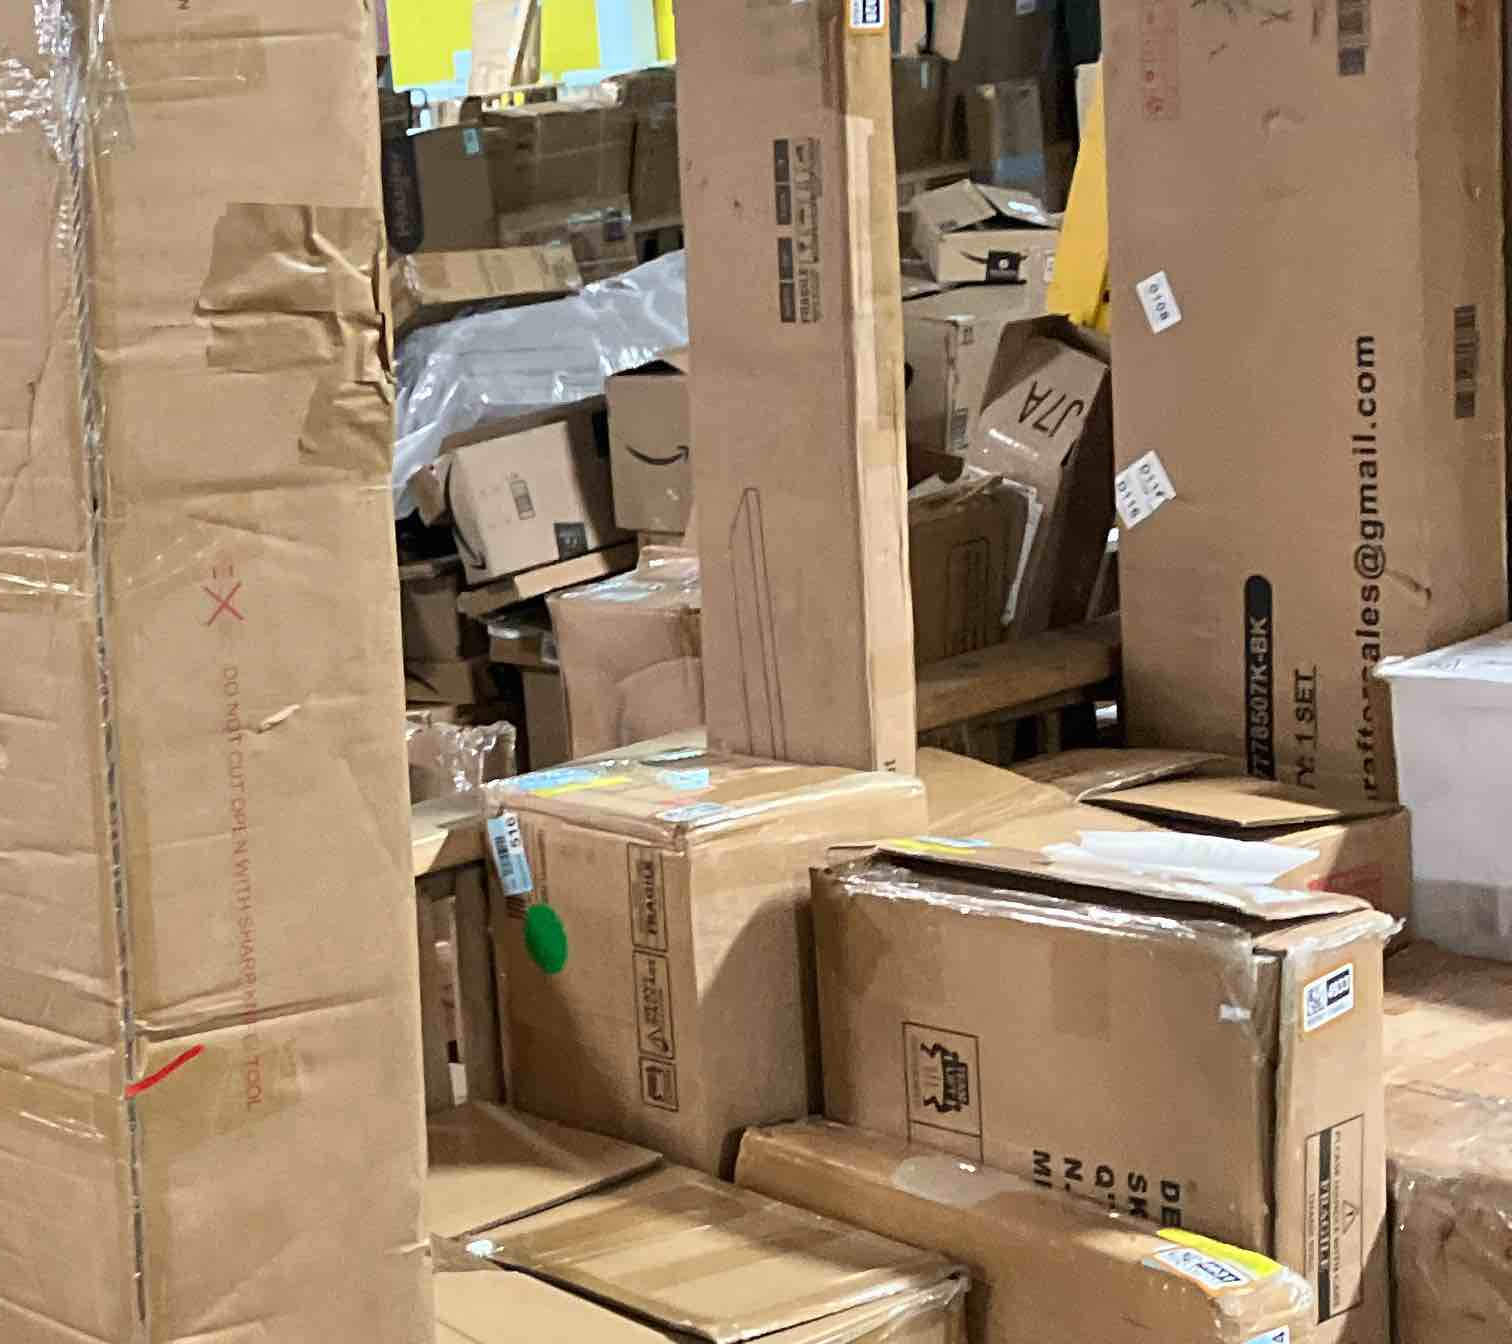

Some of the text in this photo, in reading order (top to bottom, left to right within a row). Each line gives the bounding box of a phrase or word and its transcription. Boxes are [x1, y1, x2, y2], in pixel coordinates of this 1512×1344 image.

[224, 702, 245, 746] NOT
[228, 748, 246, 793] CUT
[234, 858, 253, 913] WITH
[246, 1055, 263, 1108] TOOL
